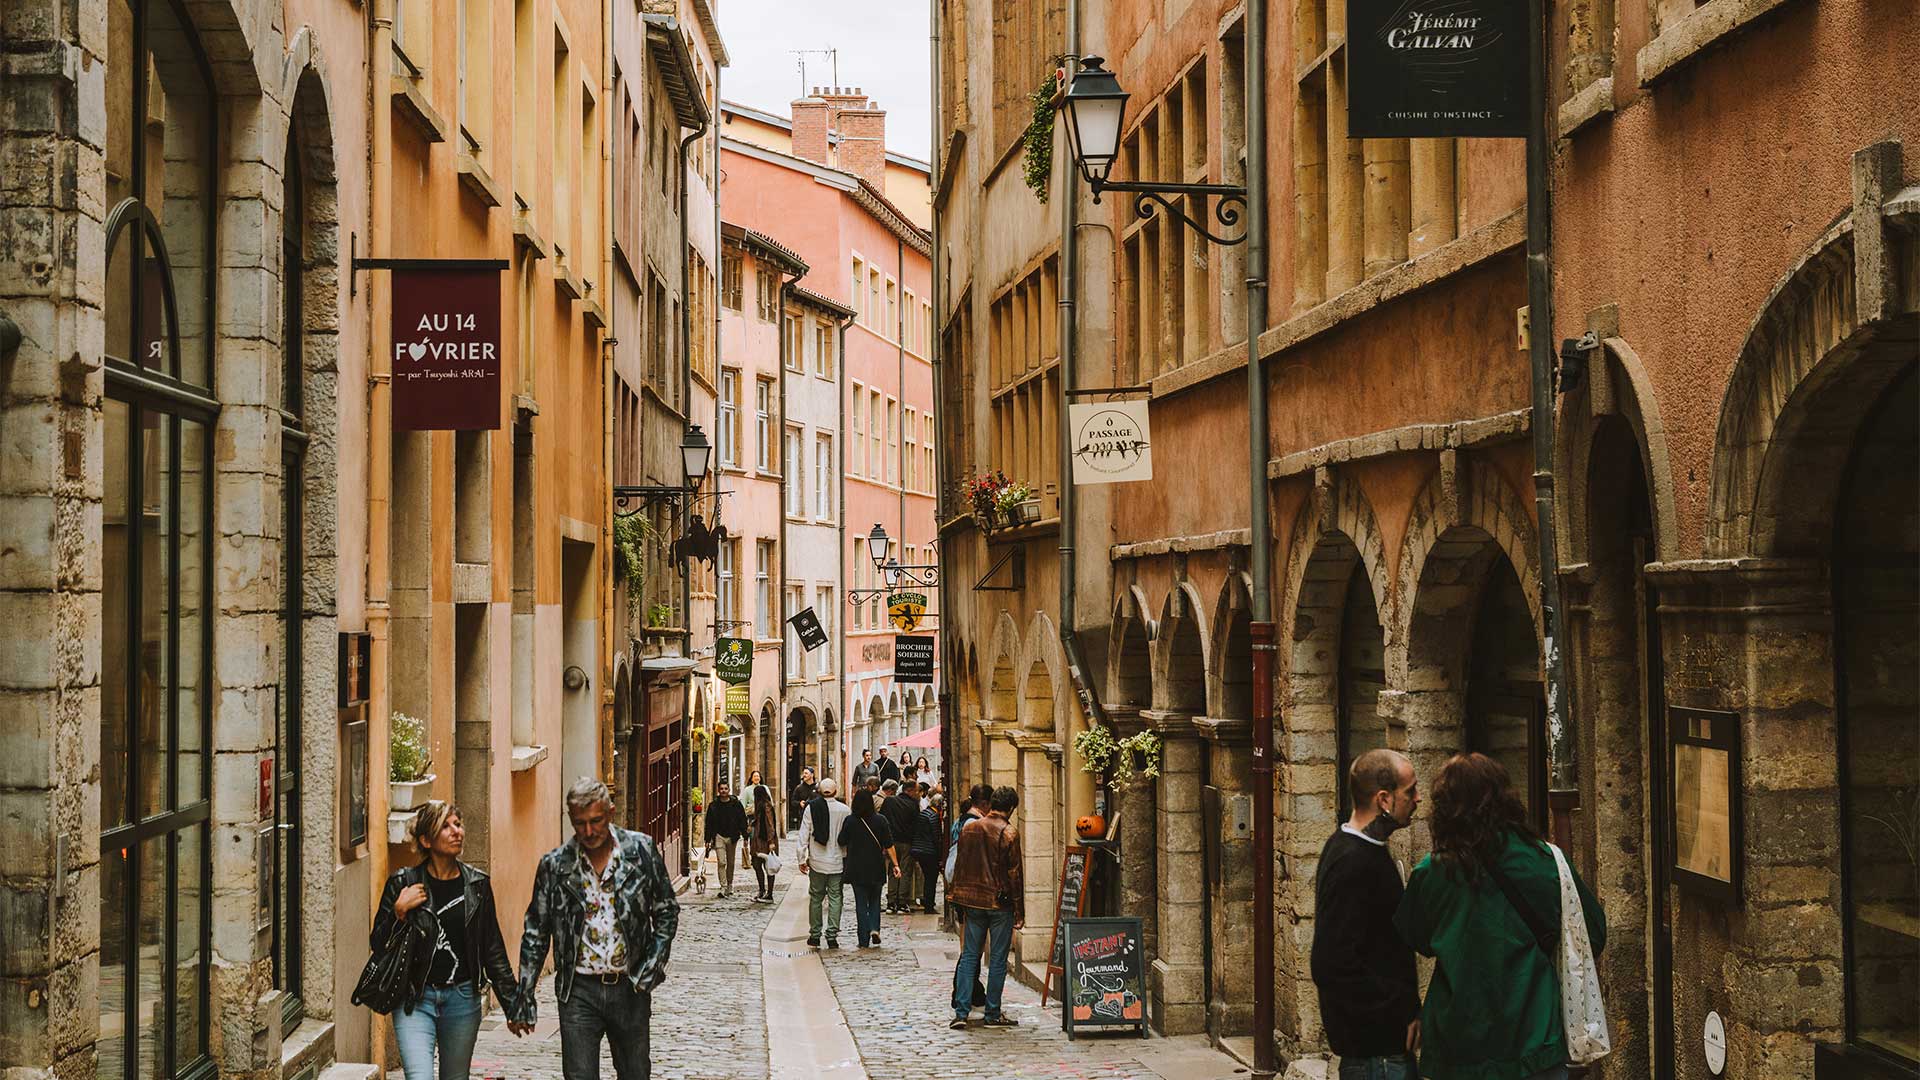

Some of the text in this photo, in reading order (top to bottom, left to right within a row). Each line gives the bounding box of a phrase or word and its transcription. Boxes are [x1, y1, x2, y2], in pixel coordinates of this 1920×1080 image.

[1408, 11, 1481, 35] JÉRÉMY
[1388, 27, 1474, 49] GALVAN
[1388, 110, 1492, 119] CUISINE D'INSTINCT
[417, 313, 476, 332] AU 14
[408, 369, 485, 381] par Tsuyoshi ARAI
[1089, 429, 1132, 439] PASSAGE
[891, 597, 922, 605] TOURISTE
[901, 592, 922, 600] CYCLO
[896, 643, 933, 651] BROCHIER
[717, 651, 731, 667] Le
[897, 651, 930, 659] SOIERIES
[718, 671, 750, 679] RESTAURANT
[1073, 932, 1127, 960] INSTANT
